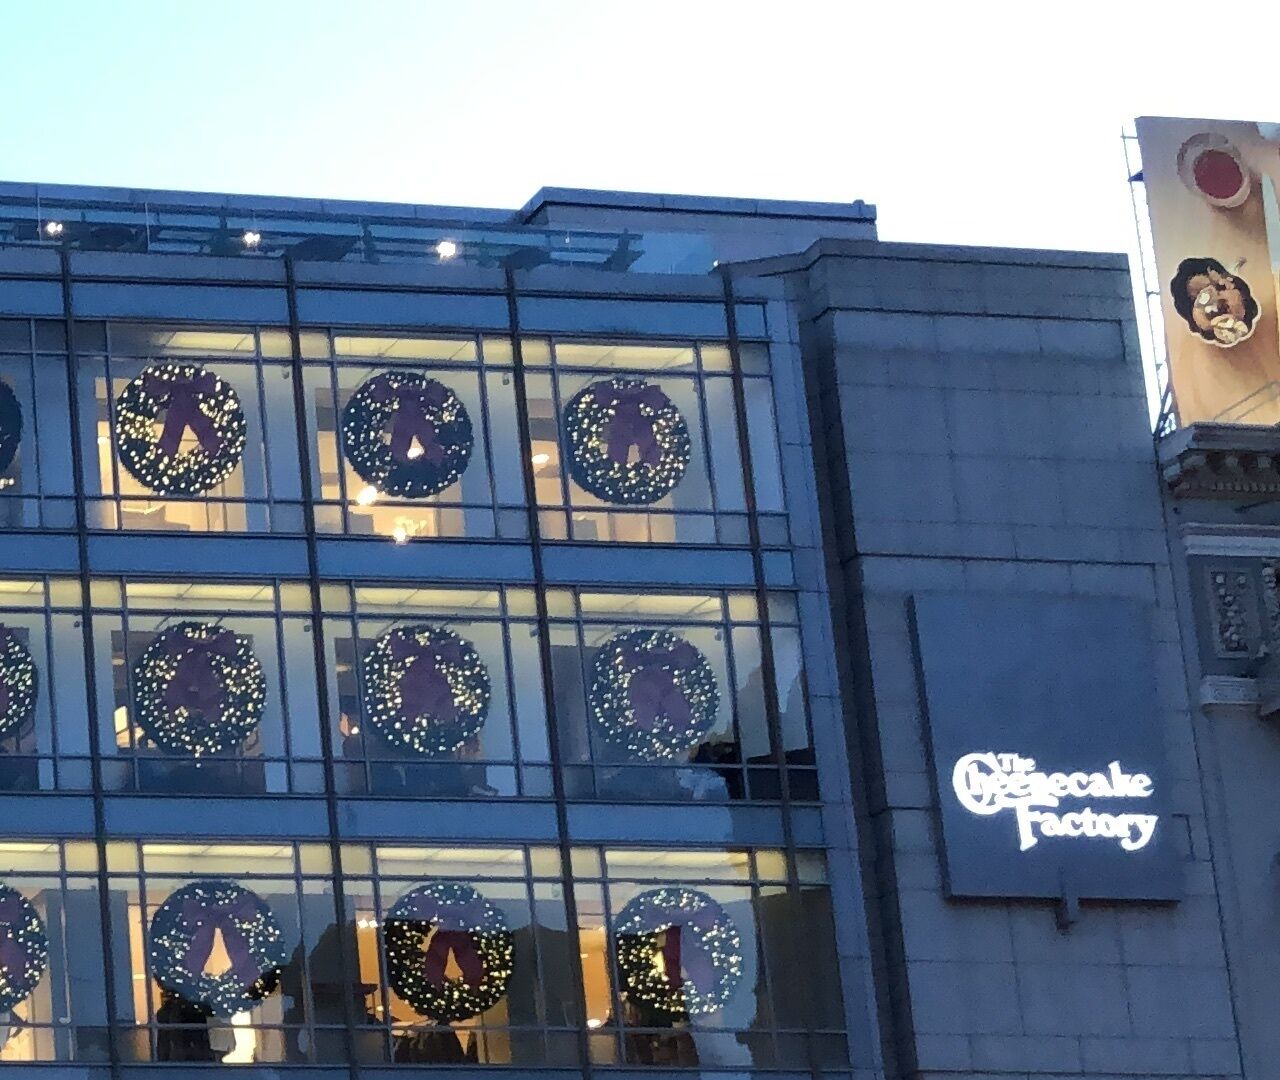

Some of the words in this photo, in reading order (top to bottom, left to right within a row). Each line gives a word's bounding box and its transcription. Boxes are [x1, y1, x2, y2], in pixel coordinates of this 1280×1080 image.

[952, 752, 1155, 816] Cheesecake
[997, 752, 1037, 773] The
[1012, 800, 1159, 851] Factory
